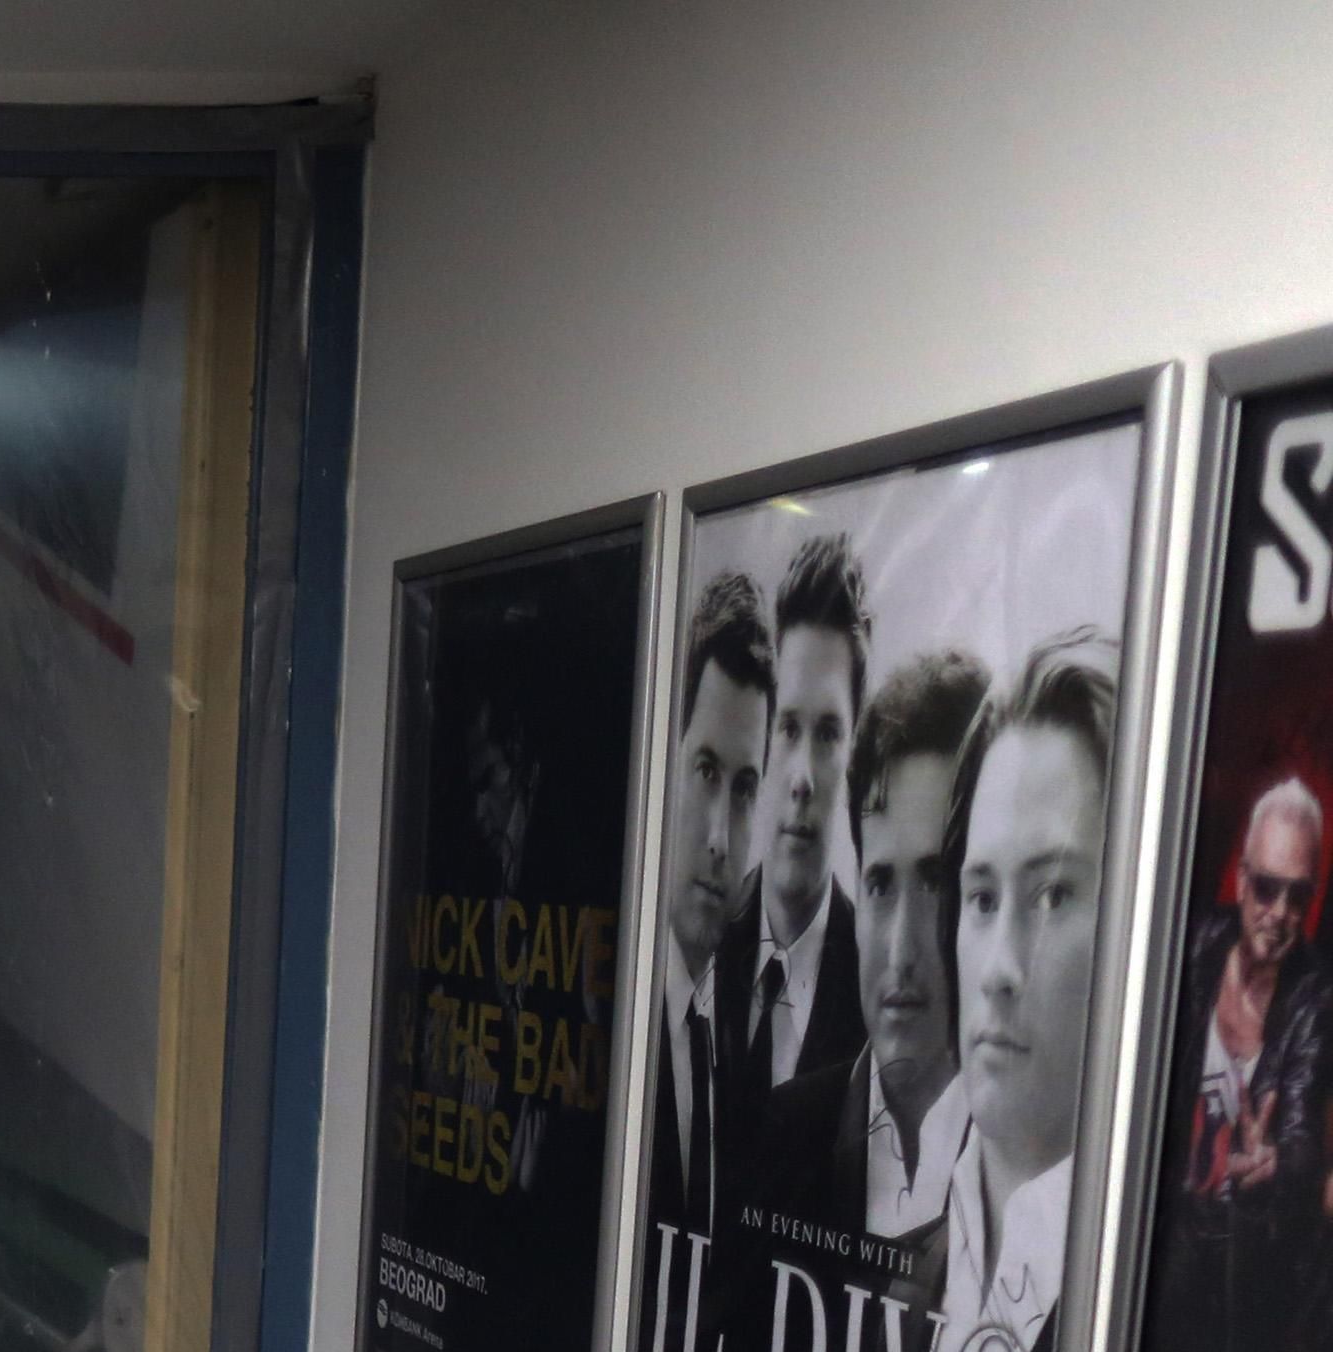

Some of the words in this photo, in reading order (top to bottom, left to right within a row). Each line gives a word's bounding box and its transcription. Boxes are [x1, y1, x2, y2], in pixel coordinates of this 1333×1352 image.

[405, 894, 486, 977] NICK
[495, 899, 616, 998] CAVE
[428, 995, 503, 1085] THE
[513, 1009, 607, 1112] BAD
[391, 1085, 512, 1197] SEEDS
[379, 1256, 446, 1313] BEOGRAD
[741, 1206, 763, 1229] AN
[771, 1215, 852, 1257] EVENING
[859, 1238, 914, 1276] WITH
